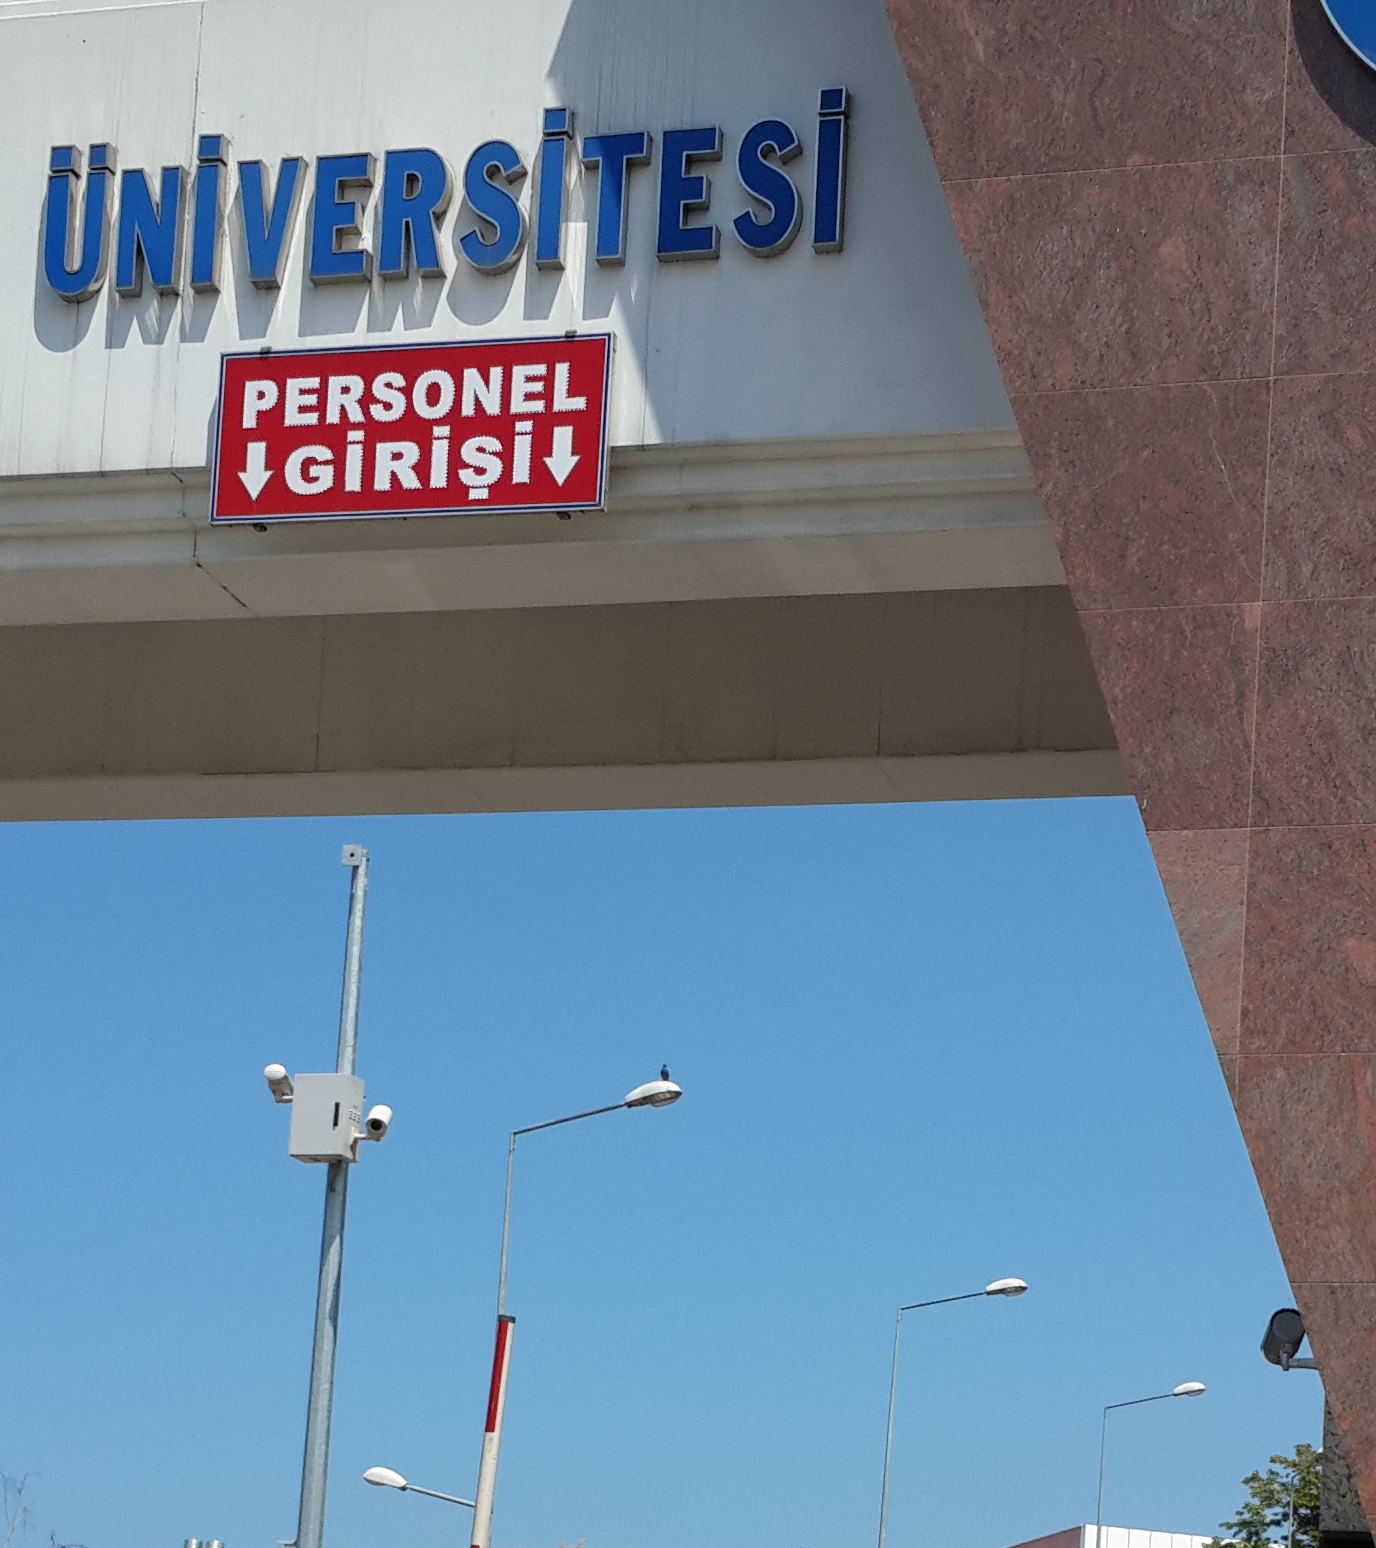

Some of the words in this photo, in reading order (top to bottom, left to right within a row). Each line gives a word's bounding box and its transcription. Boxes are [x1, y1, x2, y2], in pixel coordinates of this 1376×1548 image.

[42, 87, 850, 303] ÜNİVERSİTESİ
[242, 361, 588, 429] PERSONEL
[284, 420, 534, 501] GİRİŞİ
